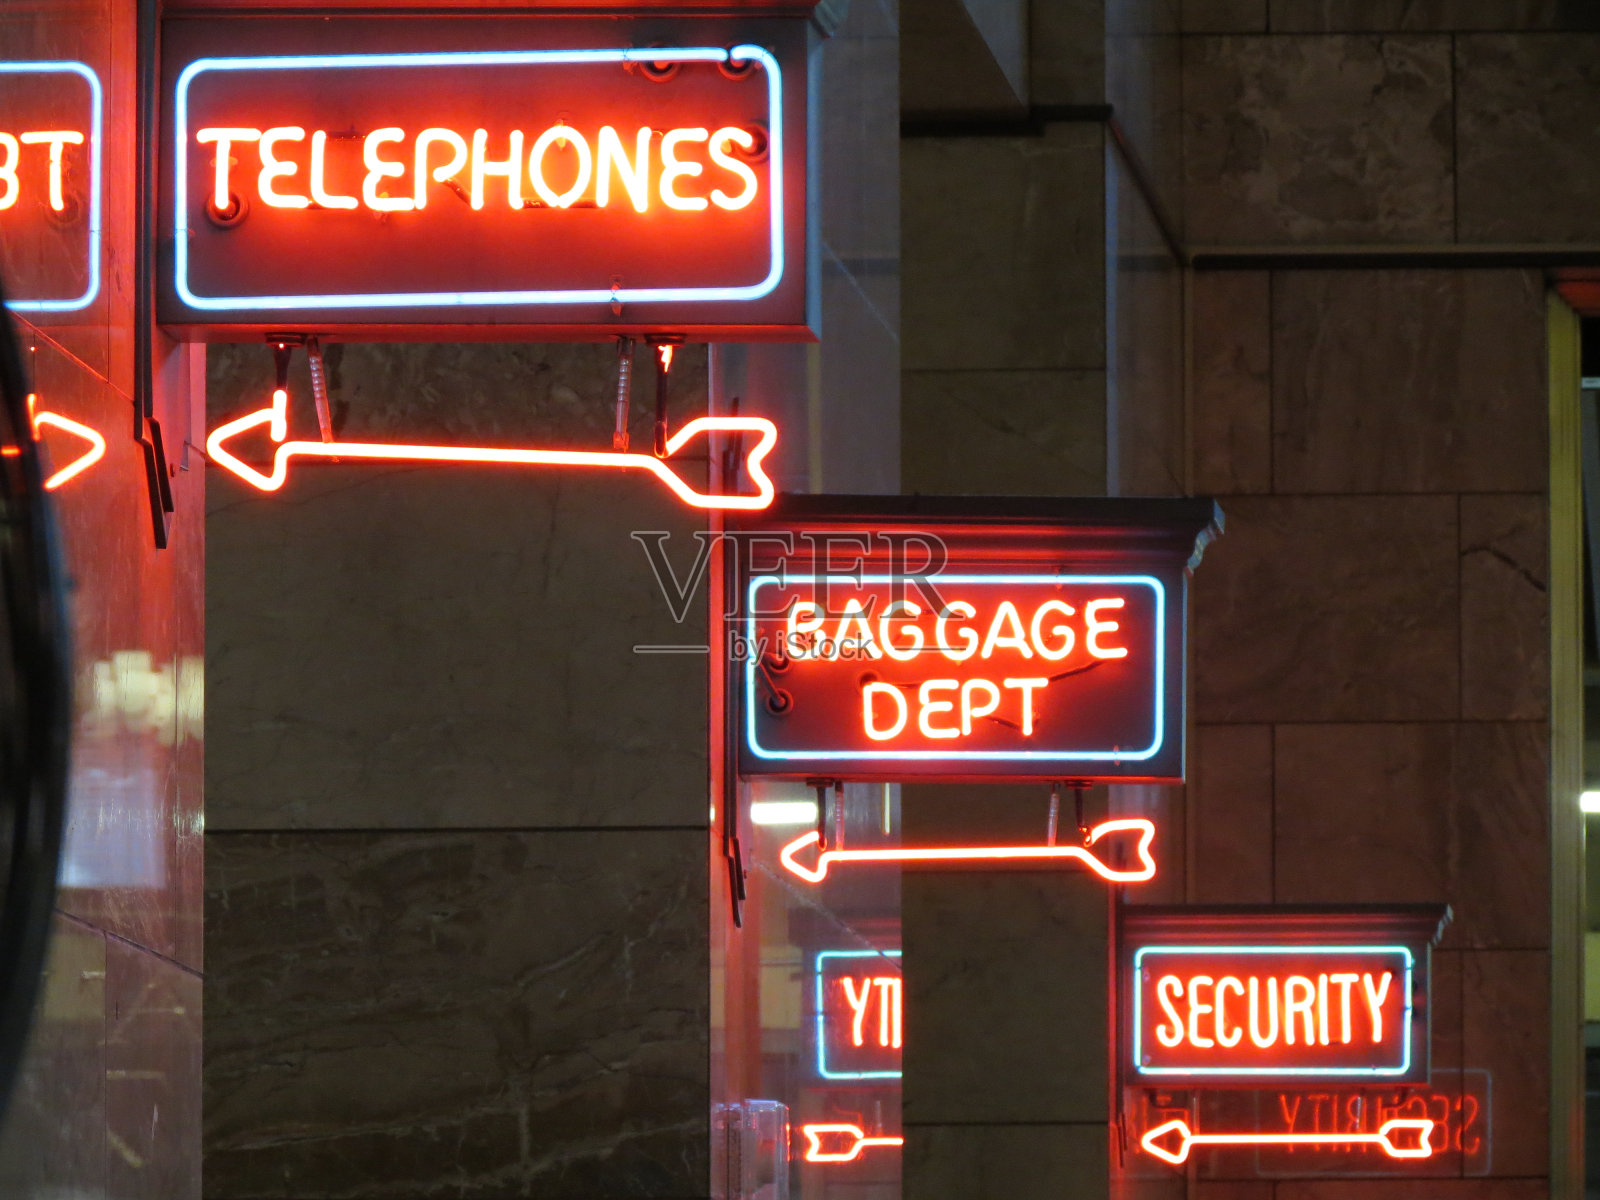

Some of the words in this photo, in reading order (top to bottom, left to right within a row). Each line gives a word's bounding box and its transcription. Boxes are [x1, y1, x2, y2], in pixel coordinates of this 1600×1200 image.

[195, 123, 760, 213] TELEPHONES
[786, 597, 1129, 663] BAGGAGE
[861, 676, 1050, 740] DEPT
[1155, 970, 1393, 1048] SECURITY
